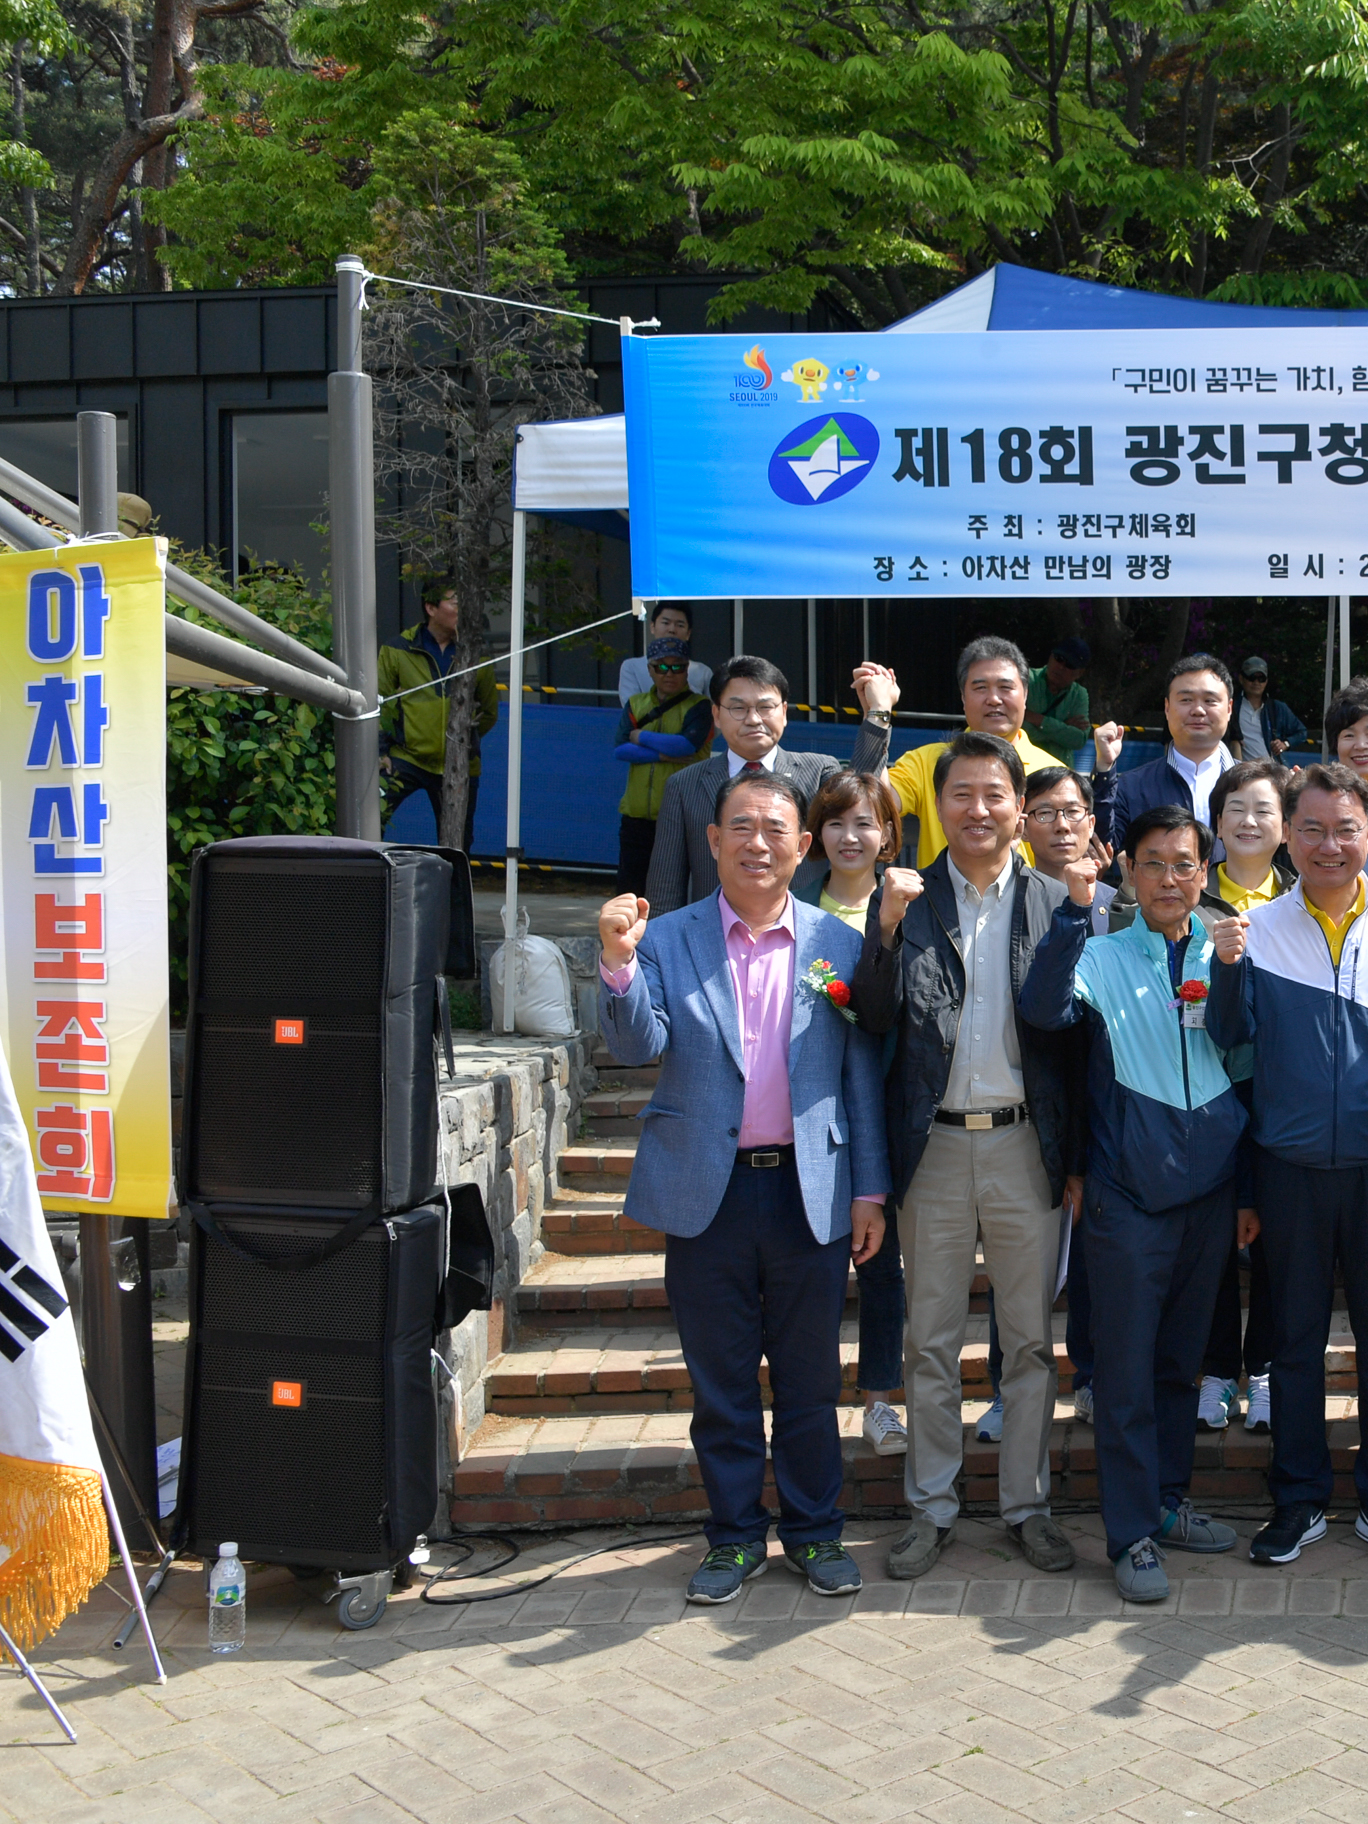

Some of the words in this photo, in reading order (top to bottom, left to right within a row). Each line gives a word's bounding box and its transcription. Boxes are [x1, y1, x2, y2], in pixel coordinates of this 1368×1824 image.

[1205, 367, 1278, 393] 꿈꾸는
[1286, 365, 1343, 395] 가치,
[729, 392, 758, 402] SEOUL
[760, 392, 778, 402] 2019
[891, 425, 1094, 488] 제18회
[1057, 512, 1196, 540] 광진구체육회
[961, 554, 1031, 581] 아차산
[1044, 554, 1112, 580] 만남의
[1125, 554, 1172, 580] 광장
[281, 1026, 299, 1038] JBL
[278, 1388, 295, 1400] JBL
